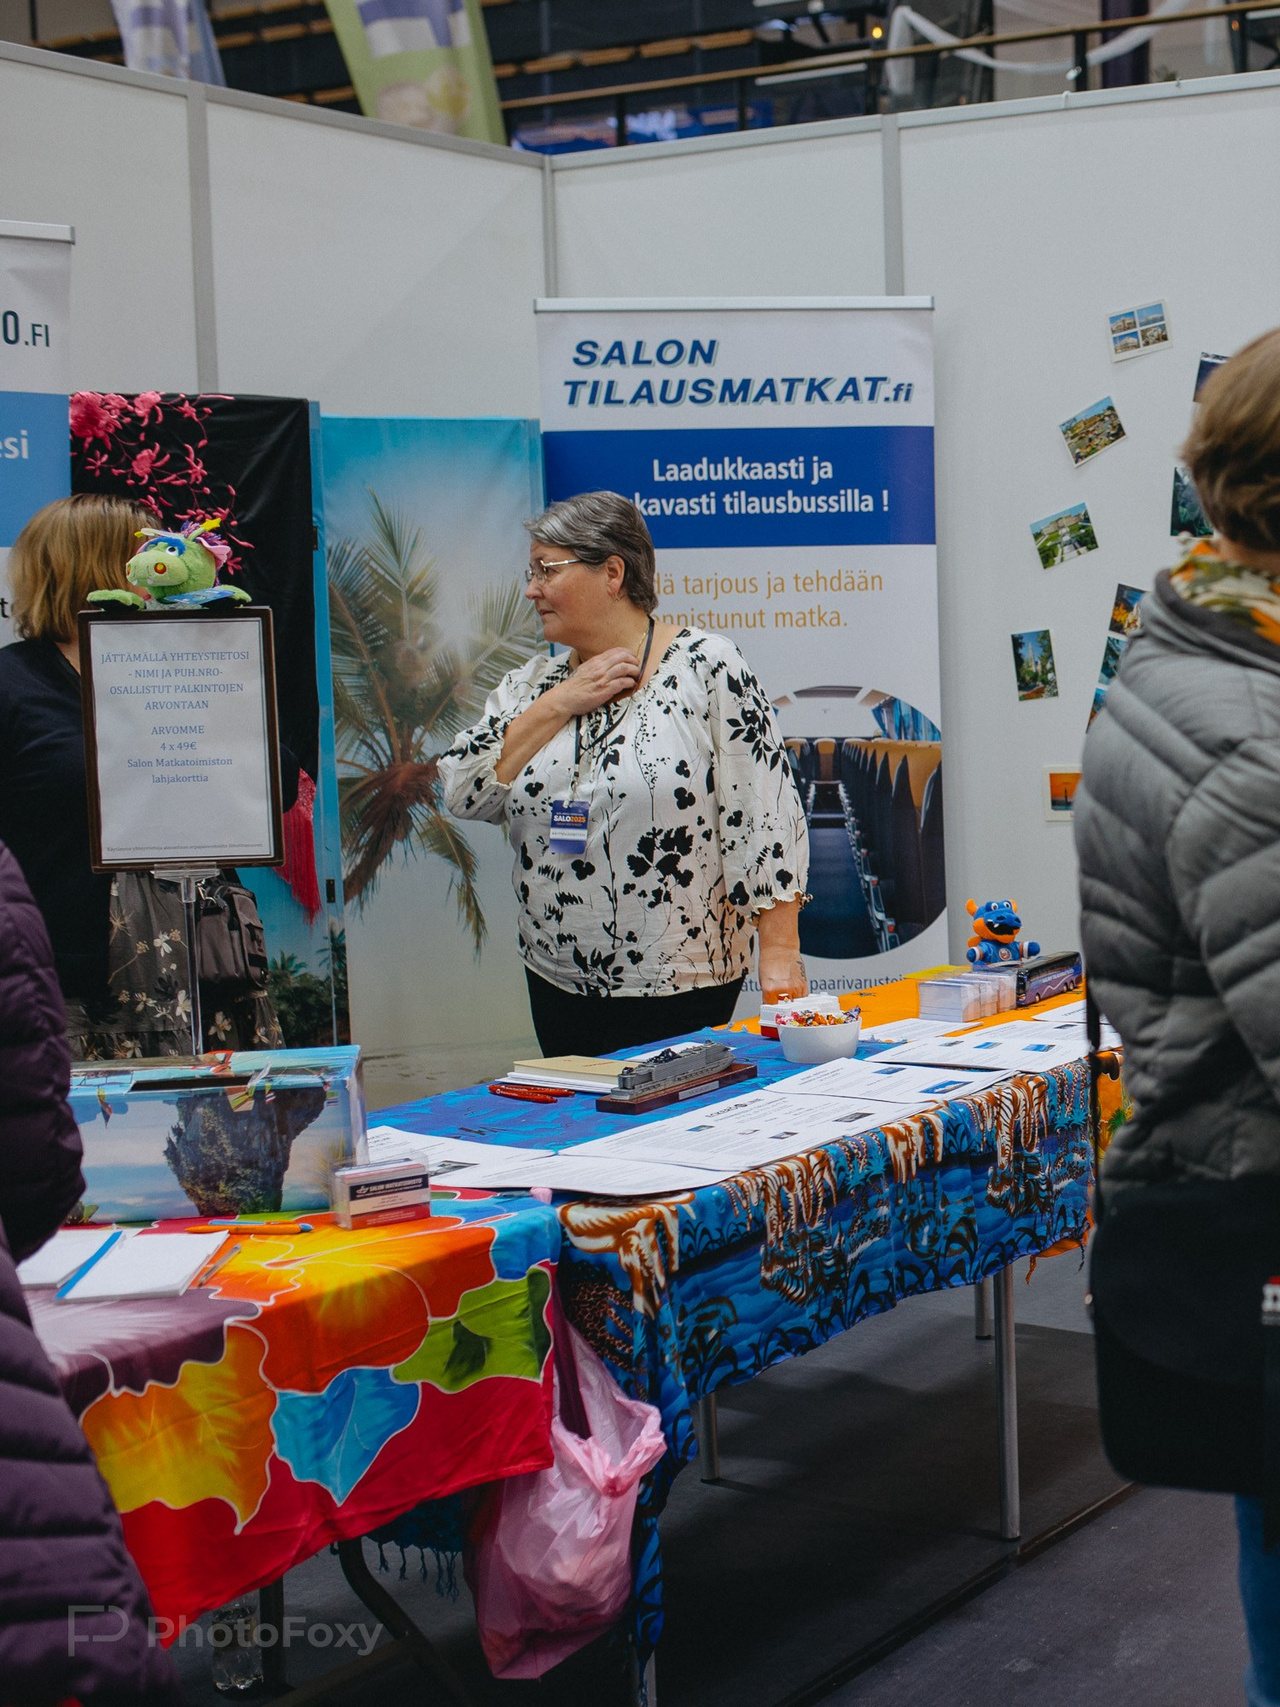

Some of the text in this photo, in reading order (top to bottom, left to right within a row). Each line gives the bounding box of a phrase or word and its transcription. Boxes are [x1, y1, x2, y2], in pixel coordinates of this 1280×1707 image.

[572, 339, 719, 369] SALON
[563, 376, 914, 407] TILAUSMATKAT.fi
[653, 457, 834, 485] Laadukkaasti ja
[630, 491, 716, 516] kavasti
[722, 489, 875, 515] tilausbussilla
[683, 572, 759, 601] tarjous
[766, 571, 785, 600] ja
[793, 568, 884, 593] tehdään
[653, 604, 848, 631] nnistunut matka.
[101, 650, 250, 664] JÄTTÄMÄLLÄ YHTEYSTIETOSI
[134, 669, 159, 679] NIMI
[161, 669, 172, 680] JA
[109, 683, 245, 695] OSALLISTUT PALKINTOJEN
[144, 700, 209, 711] ARVONTAAN
[151, 725, 206, 736] ARVOMME
[160, 741, 197, 751] 4 x 49€
[127, 757, 233, 768] Salon Matkatoimiston
[151, 773, 209, 785] lahjakorttia
